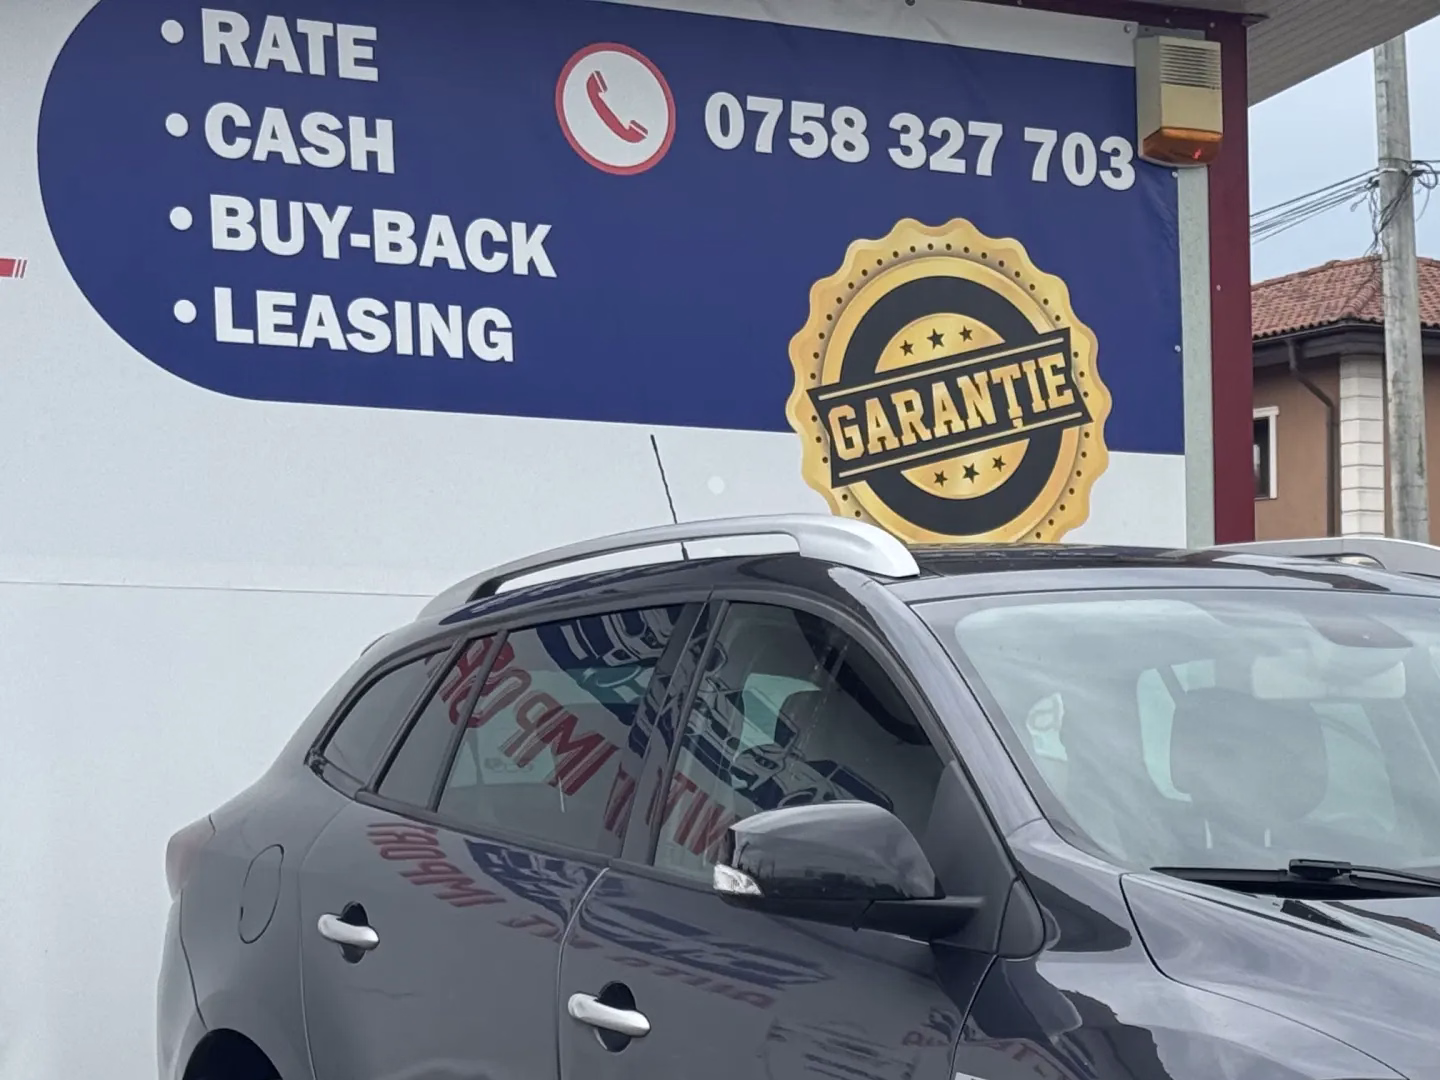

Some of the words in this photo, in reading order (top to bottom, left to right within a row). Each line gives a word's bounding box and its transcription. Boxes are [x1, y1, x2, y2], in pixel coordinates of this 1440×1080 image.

[202, 8, 378, 82] RATE
[204, 101, 395, 174] CASH
[704, 91, 870, 163] 0758
[887, 113, 1003, 176] 327
[1023, 127, 1135, 191] 703
[210, 194, 557, 278] BUY-BACK
[214, 287, 514, 362] LEASING
[828, 352, 1075, 461] GARANȚIE
